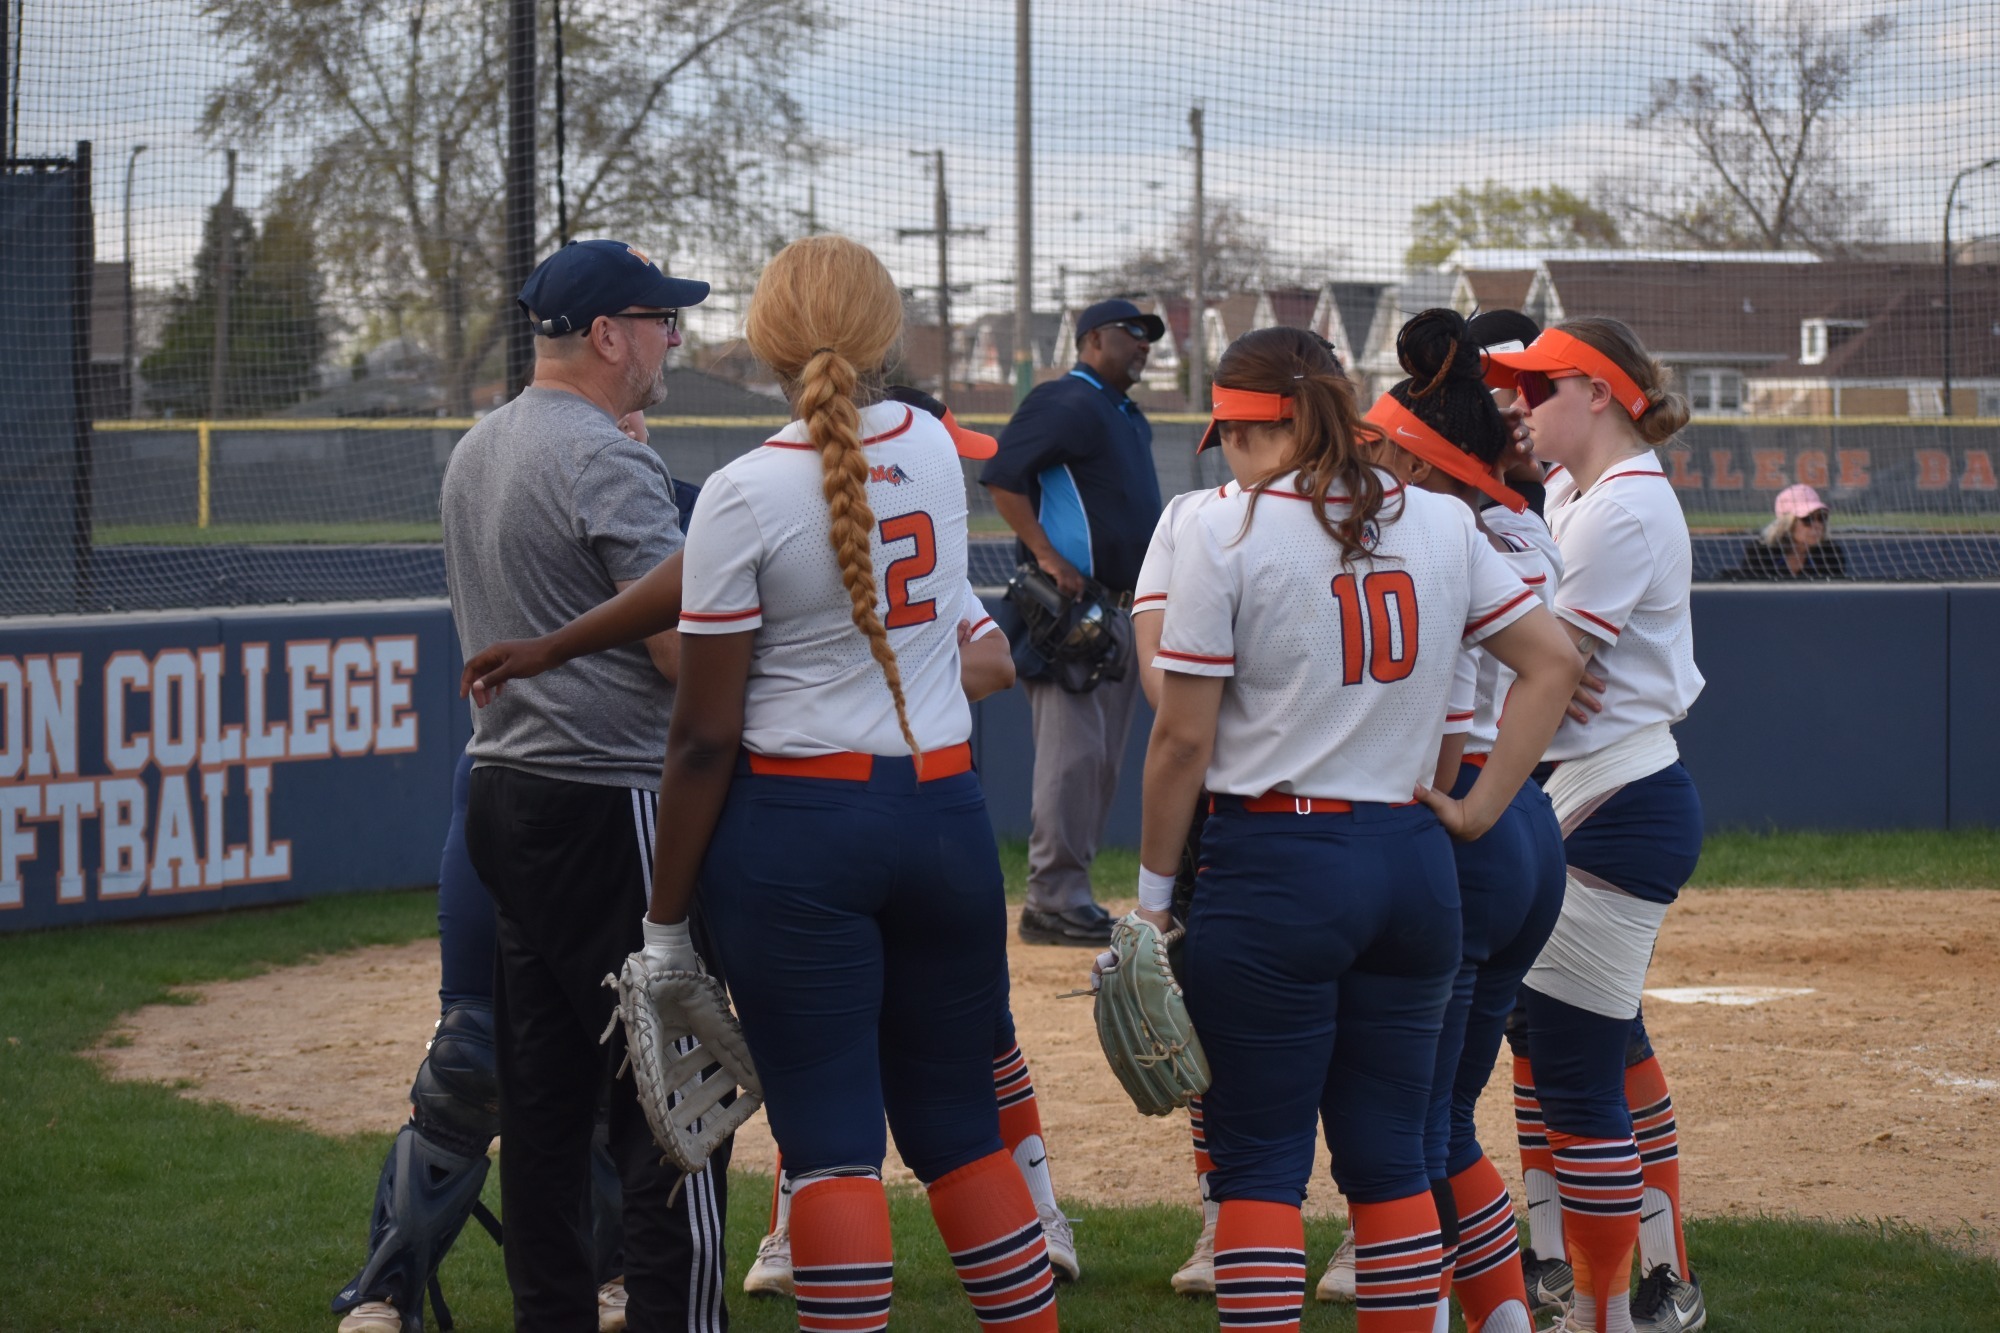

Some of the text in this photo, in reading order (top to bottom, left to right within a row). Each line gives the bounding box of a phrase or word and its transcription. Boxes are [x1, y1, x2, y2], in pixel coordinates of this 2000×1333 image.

[1668, 448, 1998, 491] LLEGE BA
[878, 510, 937, 630] 2
[1330, 570, 1419, 686] 10
[104, 635, 418, 773] COLLEGE
